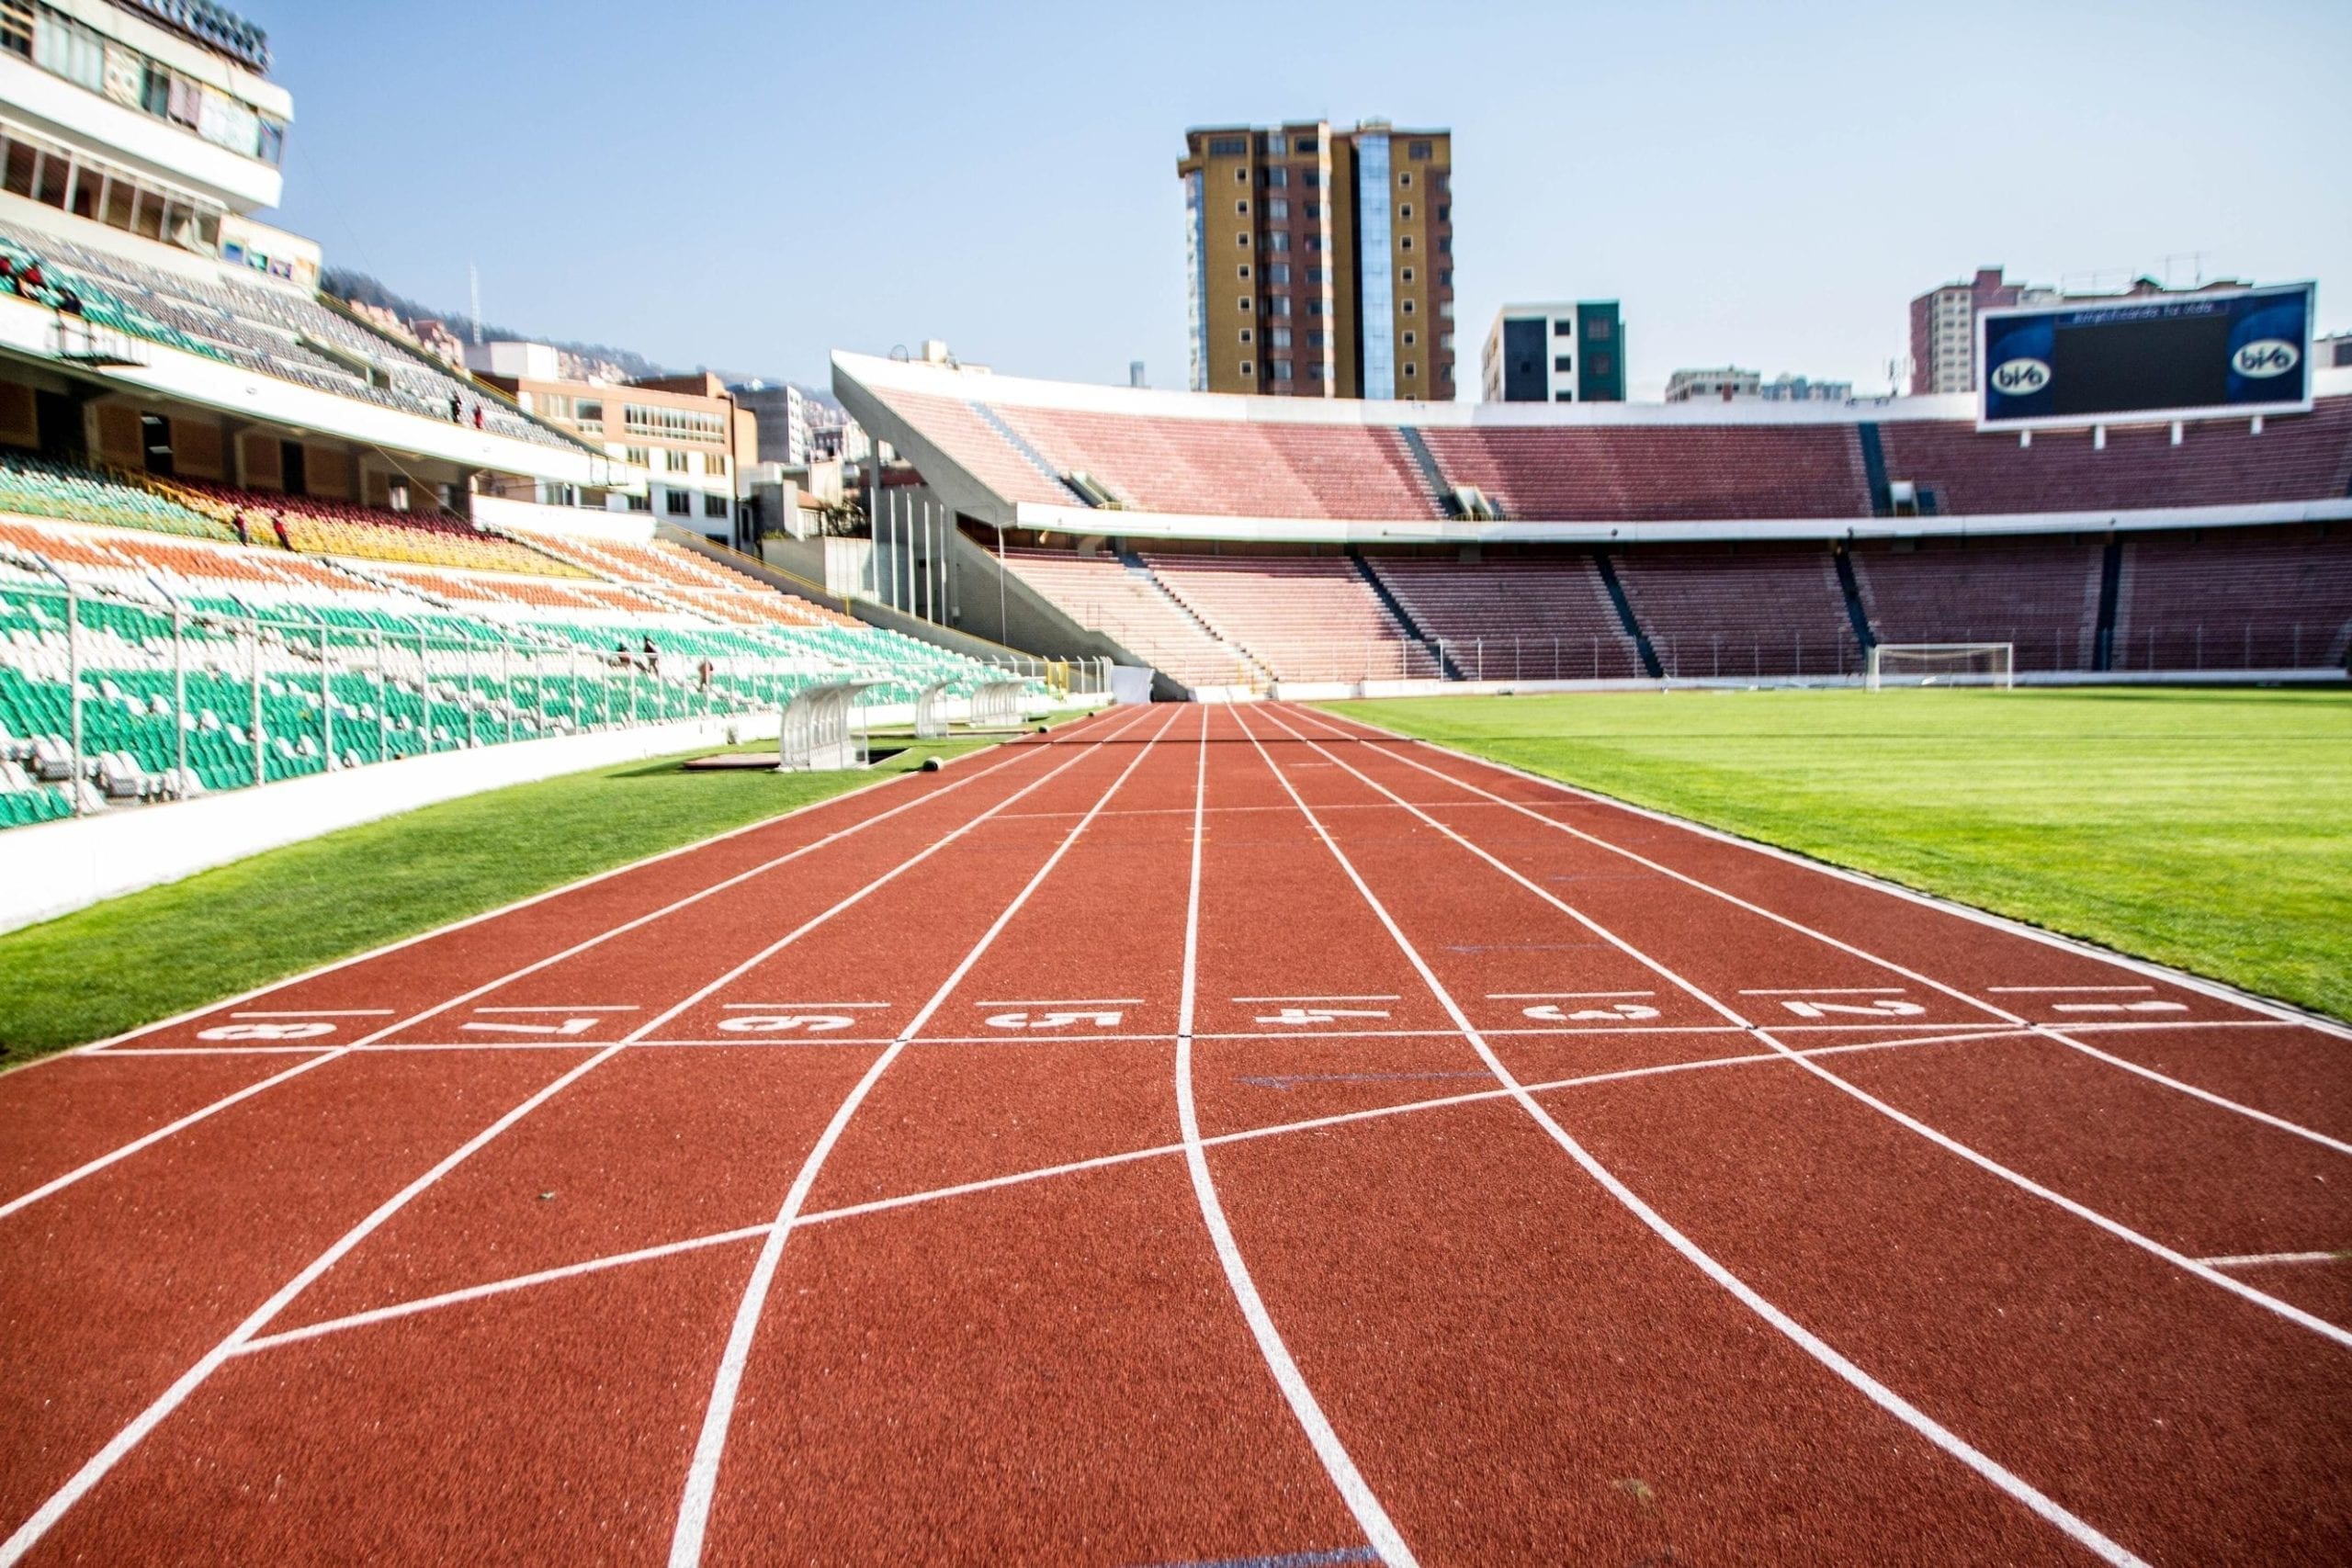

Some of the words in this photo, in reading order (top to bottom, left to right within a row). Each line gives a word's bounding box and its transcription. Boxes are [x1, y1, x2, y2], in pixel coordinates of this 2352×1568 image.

[1522, 1005, 1661, 1021] 3
[1781, 1000, 1926, 1017] 2
[2052, 1000, 2190, 1012] 1
[718, 1015, 855, 1032] 6
[984, 1011, 1123, 1028] 5
[1254, 1009, 1390, 1024] 4
[197, 1022, 338, 1040] 8
[458, 1019, 600, 1034] 7
